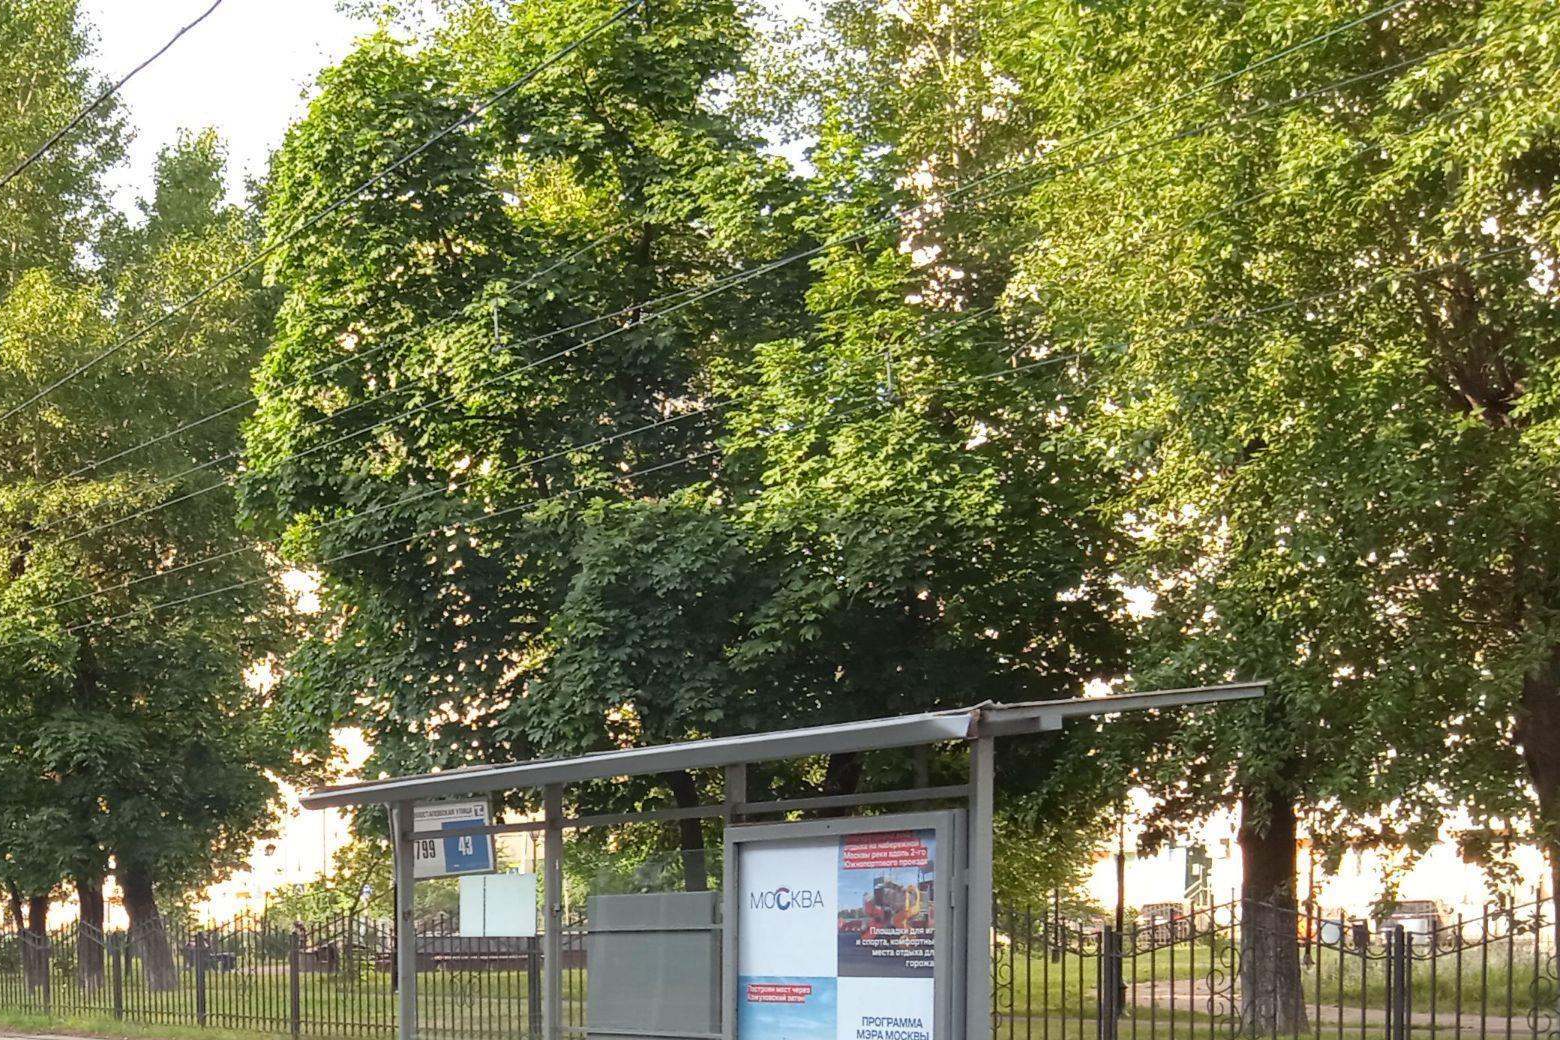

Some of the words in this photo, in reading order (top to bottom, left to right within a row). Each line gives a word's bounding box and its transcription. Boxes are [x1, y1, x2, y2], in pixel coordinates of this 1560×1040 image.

[416, 839, 436, 860] 799
[458, 835, 474, 856] 43
[750, 887, 824, 911] МОСКВА
[870, 926, 909, 935] Площадки
[872, 949, 895, 957] места
[895, 949, 924, 957] отдыха
[862, 1016, 923, 1028] ПРОГРАММА
[856, 1029, 884, 1040] МЭРА
